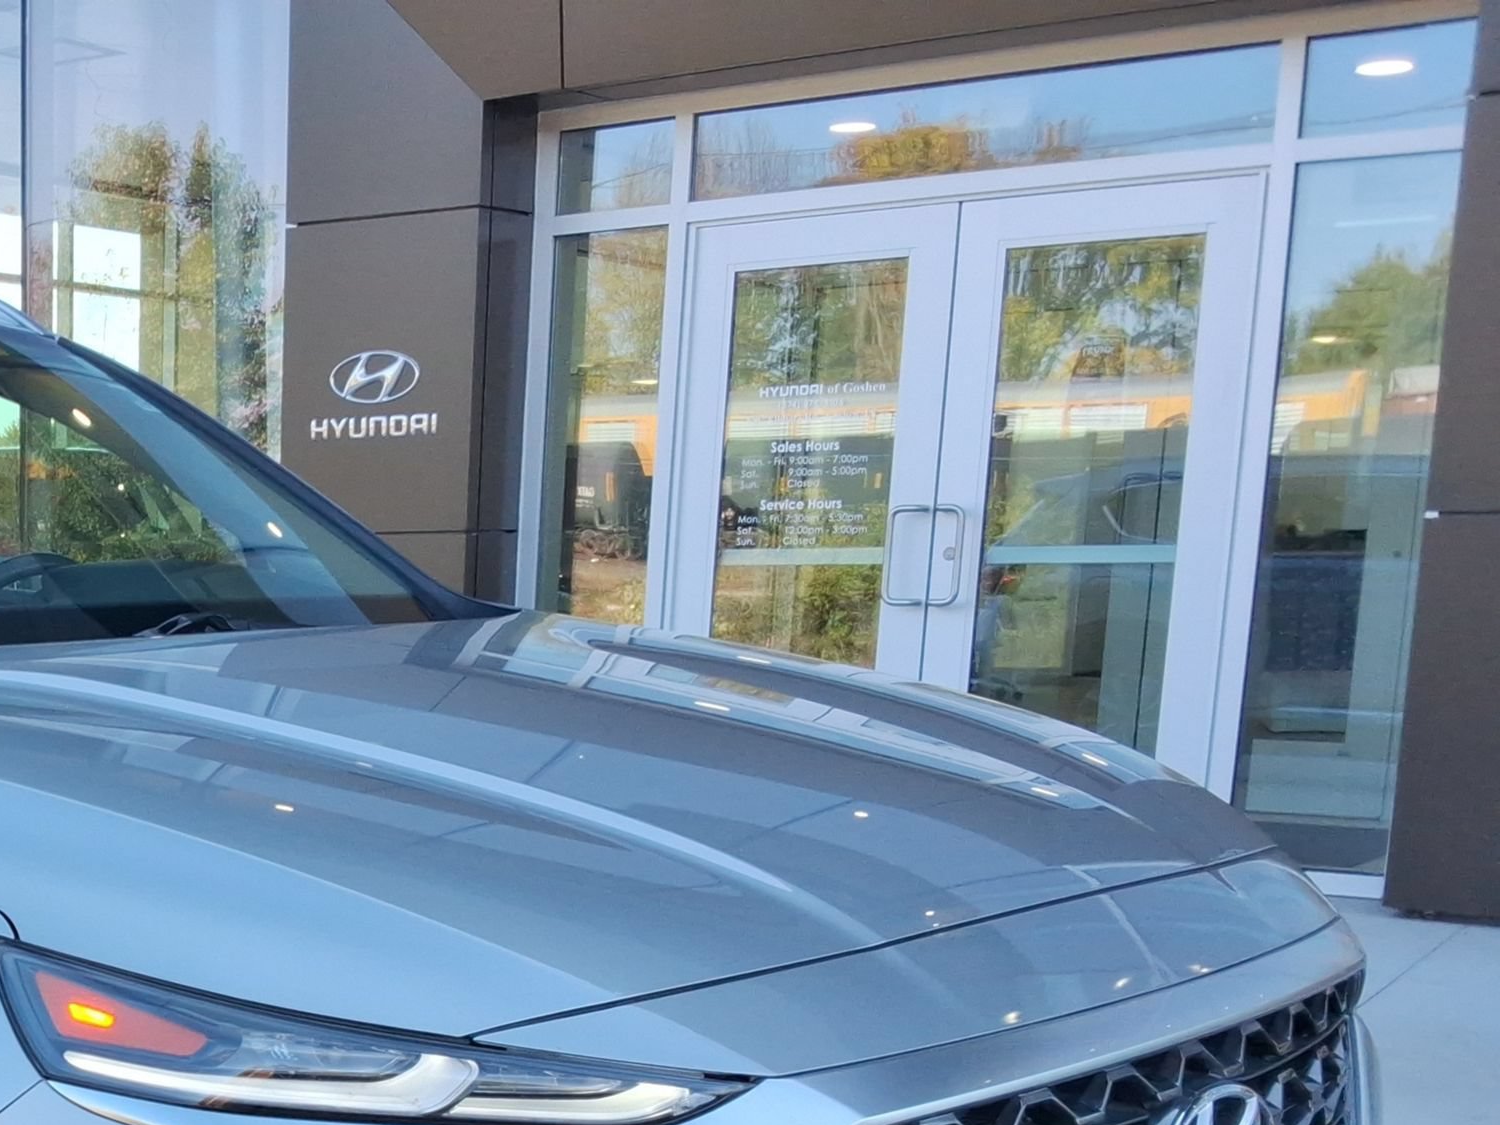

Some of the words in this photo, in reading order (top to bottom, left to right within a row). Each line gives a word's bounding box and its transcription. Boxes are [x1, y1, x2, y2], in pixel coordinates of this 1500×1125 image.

[759, 384, 823, 398] HYUNDAI
[828, 383, 841, 394] of
[843, 381, 886, 394] Goshen
[310, 412, 438, 440] HYUNDAI
[770, 441, 802, 453] Sales
[805, 441, 840, 452] Hours
[833, 454, 869, 464] 7:00pm
[740, 470, 759, 479] Sat.
[788, 467, 823, 477] 9:00am
[832, 466, 867, 476] 5:00pm
[787, 479, 820, 489] Closed
[760, 499, 805, 511] Service
[807, 499, 842, 510] Hours
[738, 515, 761, 524] Mon.
[736, 537, 755, 546] Sun.
[783, 536, 816, 546] Closed
